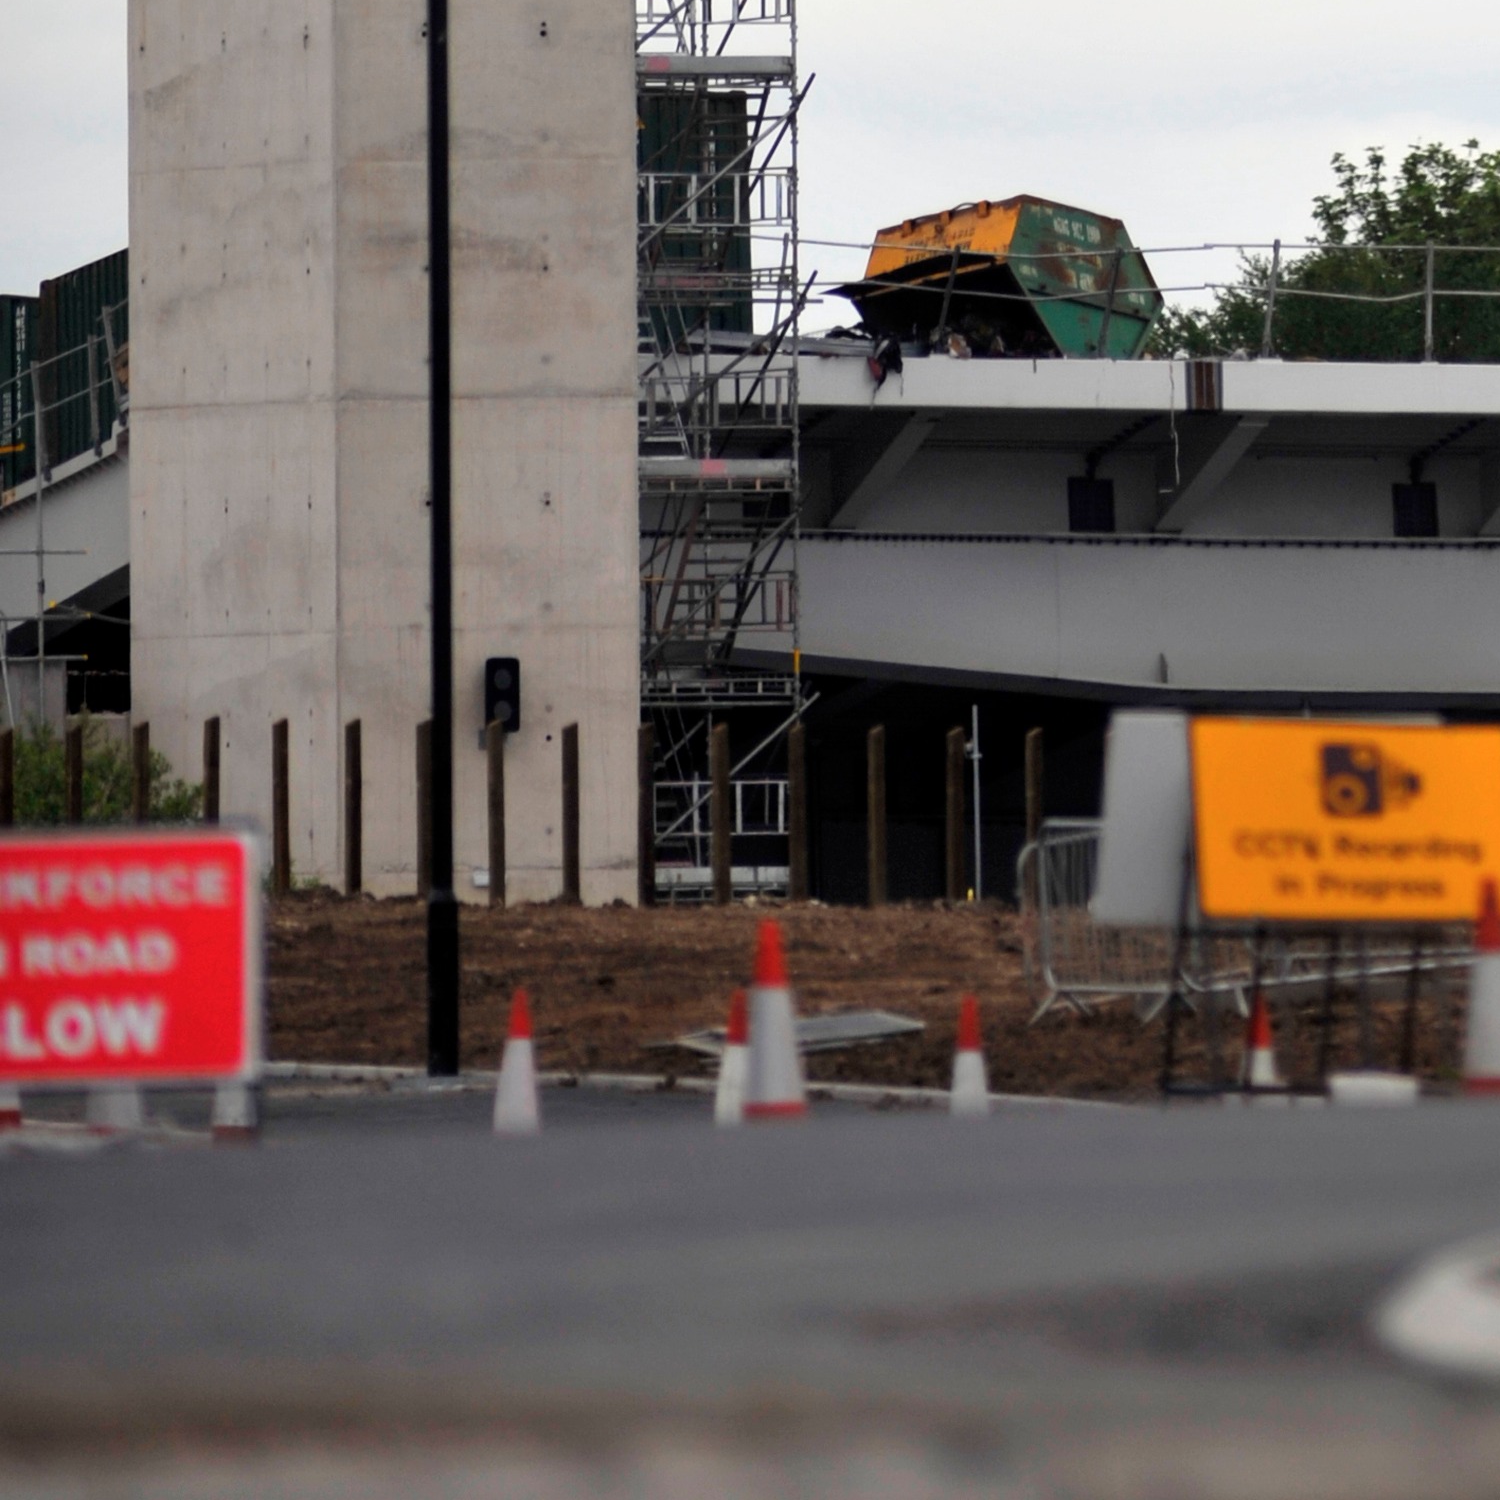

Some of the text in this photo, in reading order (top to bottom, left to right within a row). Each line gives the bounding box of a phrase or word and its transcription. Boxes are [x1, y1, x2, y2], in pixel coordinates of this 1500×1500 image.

[1333, 833, 1482, 865] Recording
[0, 867, 226, 909] KFORCE
[1315, 870, 1445, 903] Progress
[23, 931, 174, 975] ROAD
[0, 1000, 164, 1058] LOW
